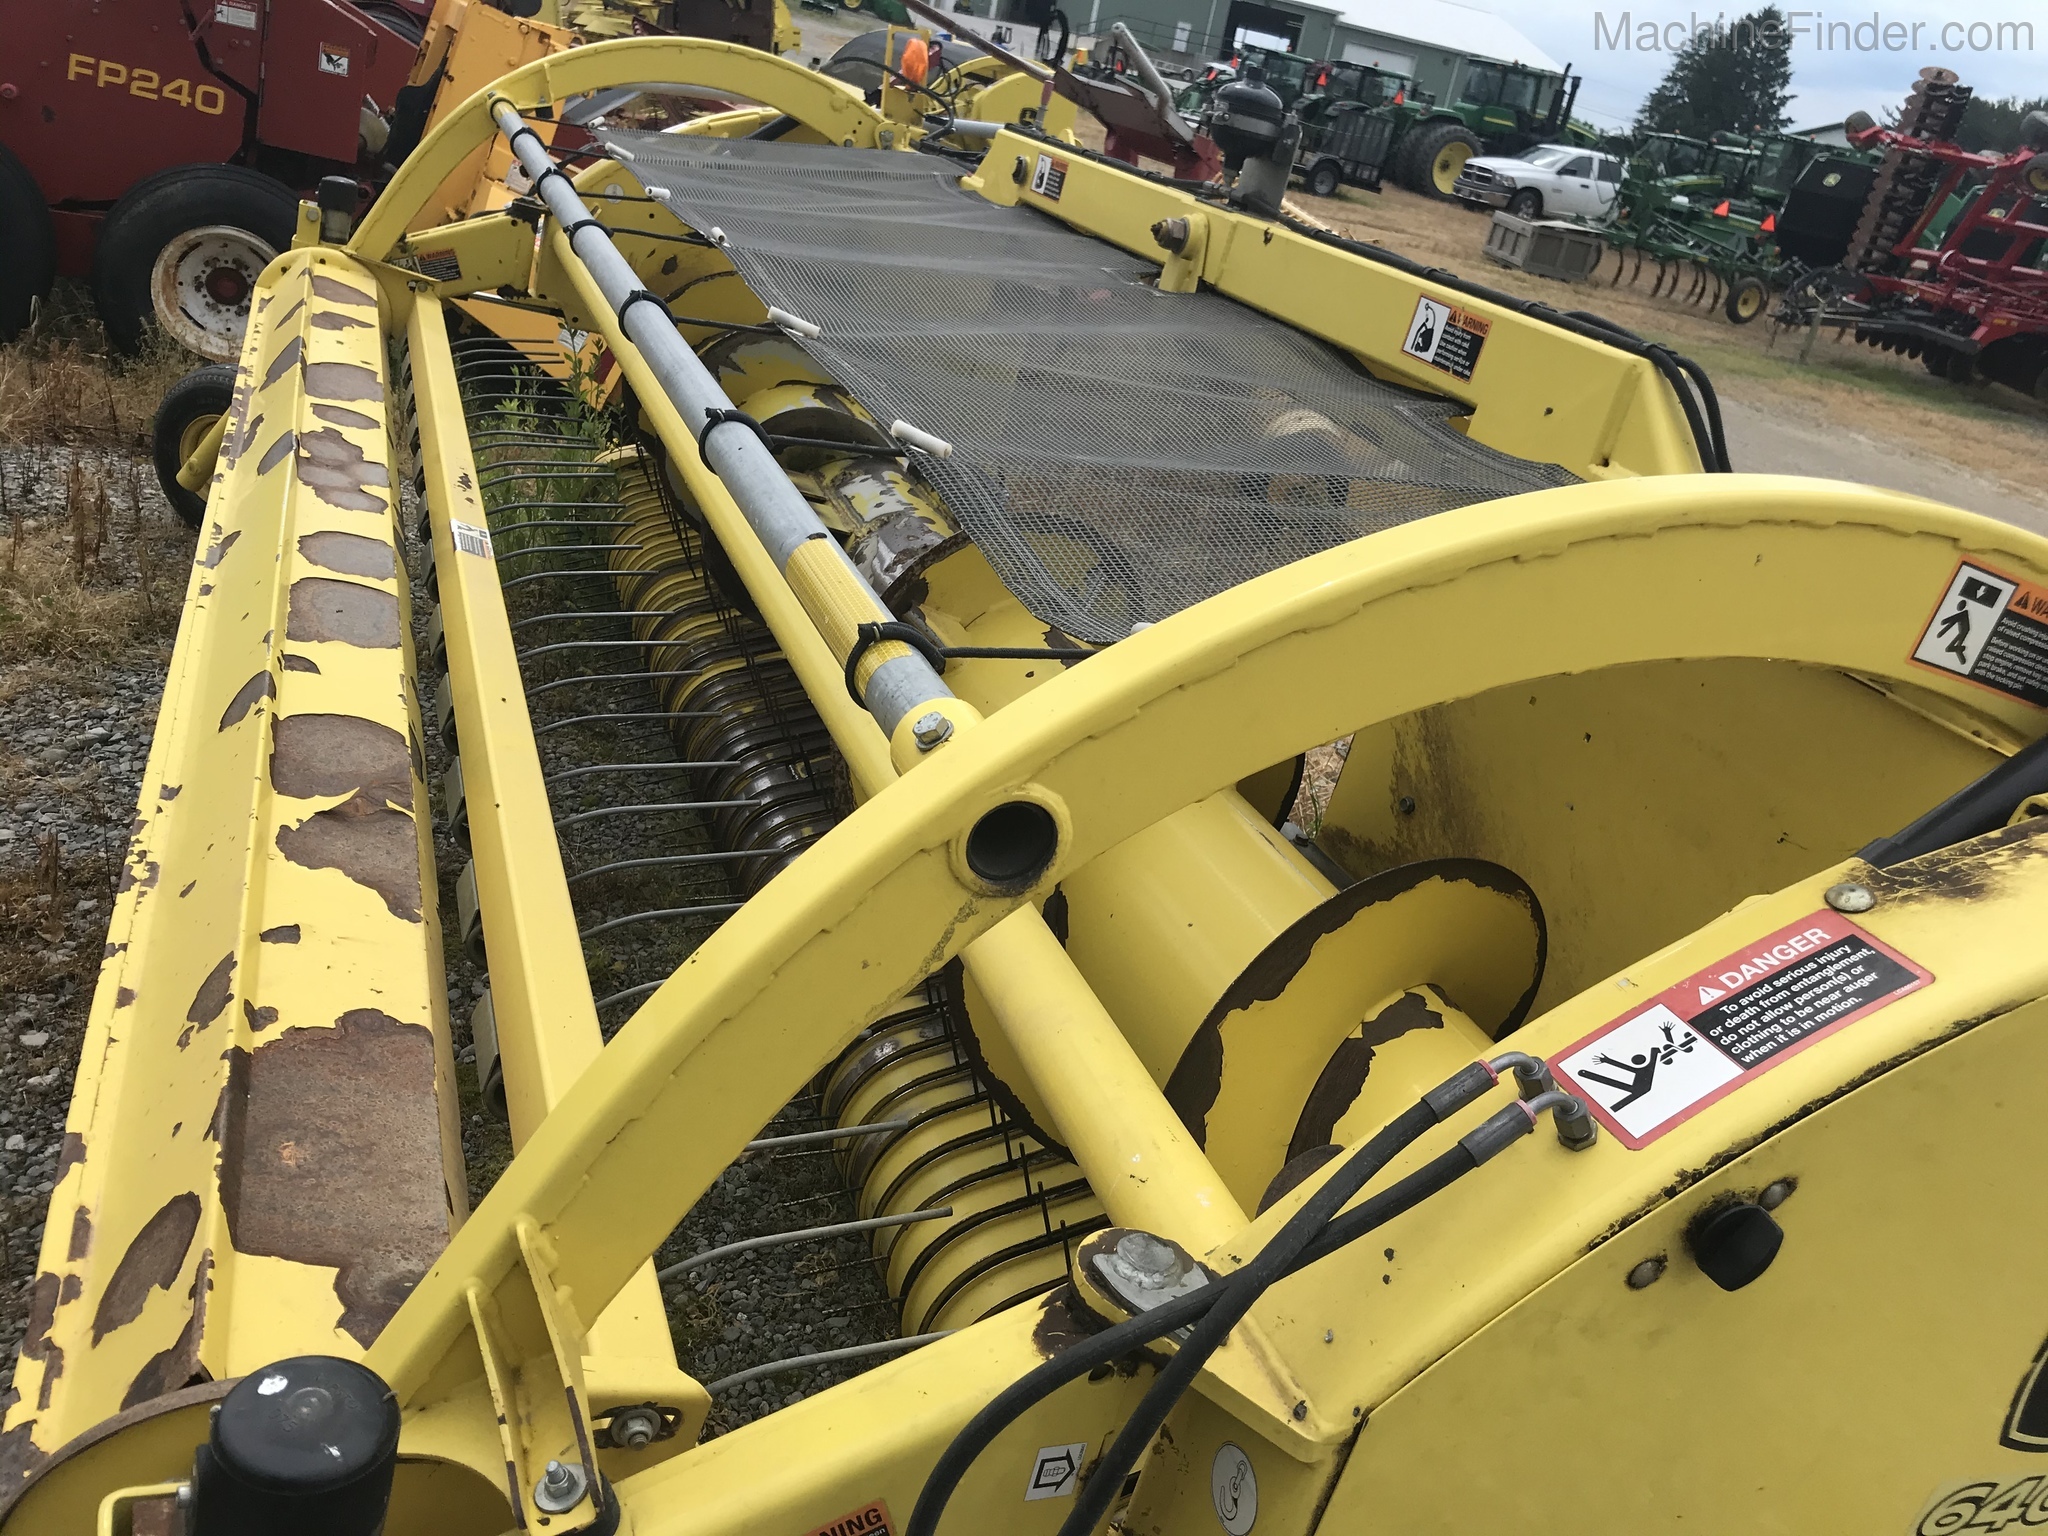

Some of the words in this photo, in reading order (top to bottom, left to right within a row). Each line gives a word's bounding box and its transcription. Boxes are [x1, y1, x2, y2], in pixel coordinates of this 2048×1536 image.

[67, 53, 225, 115] FP240
[1991, 637, 2009, 648] Before
[2008, 645, 2029, 657] working
[2001, 617, 2018, 628] Avoid
[2016, 624, 2039, 637] crushing
[2003, 629, 2021, 639] raised
[1977, 660, 1991, 669] park
[2006, 671, 2019, 679] and
[1982, 653, 1995, 662] stop
[2013, 665, 2033, 676] remove
[1986, 646, 2005, 656] raised
[2003, 652, 2035, 668] compression
[1985, 671, 1996, 680] the
[1995, 675, 2014, 688] locking
[1718, 928, 1832, 990] DANGER
[1719, 1004, 1738, 1014] To
[1739, 984, 1773, 1006] avoid
[1772, 962, 1818, 988] serious
[1814, 945, 1851, 964] injury
[1709, 1026, 1723, 1037] or
[1724, 1006, 1761, 1028] death
[1759, 990, 1791, 1008] from
[1790, 948, 1876, 992] entanglement,
[1720, 1033, 1738, 1046] do
[1738, 1020, 1761, 1035] not
[1760, 1002, 1794, 1023] allow
[1793, 972, 1852, 1006] person(s)
[1850, 964, 1865, 975] or
[1731, 1024, 1783, 1054] clothing
[1779, 1016, 1796, 1026] to
[1793, 1006, 1814, 1018] be
[1813, 990, 1842, 1008] near
[1843, 972, 1878, 993] auger
[1741, 1041, 1778, 1063] when
[1774, 1033, 1789, 1043] it
[1785, 1027, 1801, 1037] is
[1798, 1020, 1815, 1030] in
[1814, 997, 1862, 1022] motion.
